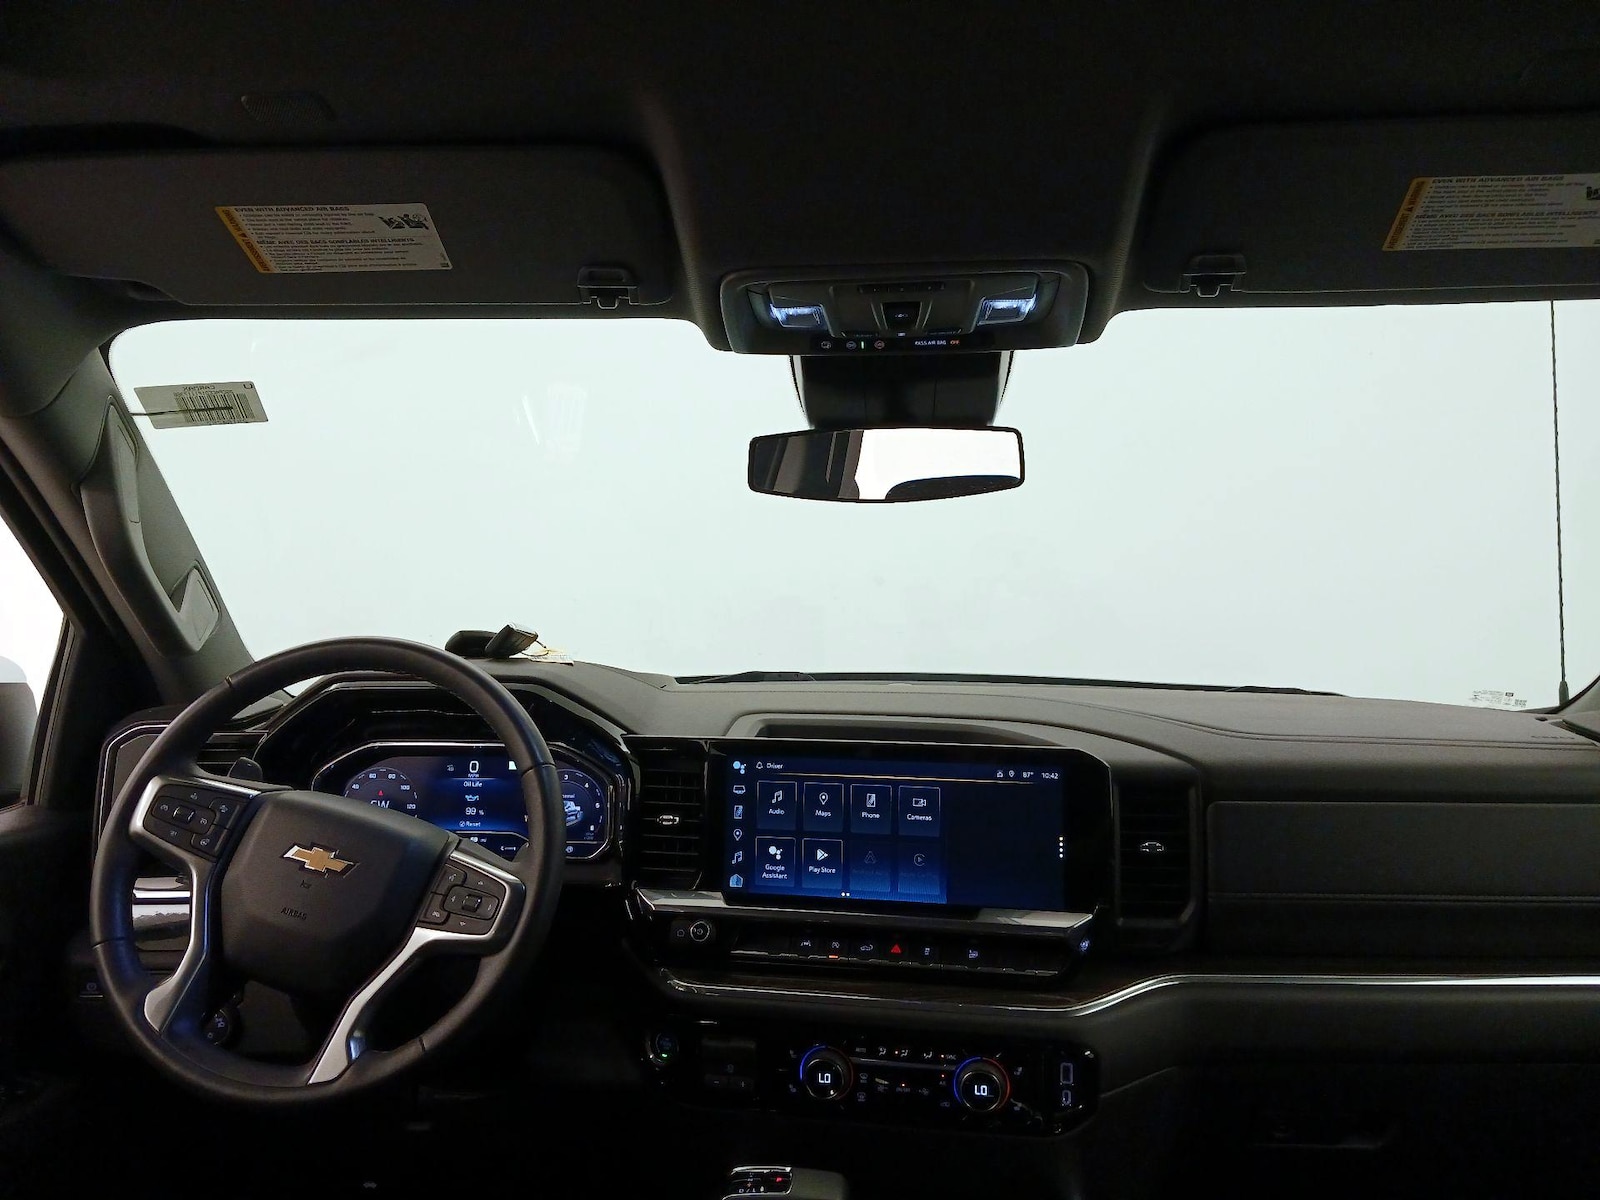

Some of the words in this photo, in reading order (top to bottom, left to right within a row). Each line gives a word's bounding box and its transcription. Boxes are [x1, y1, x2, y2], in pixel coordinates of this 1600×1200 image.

[463, 780, 471, 788] Oil
[472, 780, 483, 788] Life
[815, 809, 832, 818] Maps
[861, 811, 880, 819] Phone
[906, 814, 933, 822] Cameras
[466, 820, 481, 828] Reset
[765, 863, 786, 872] Google
[808, 865, 822, 874] Play
[822, 866, 836, 874] Store
